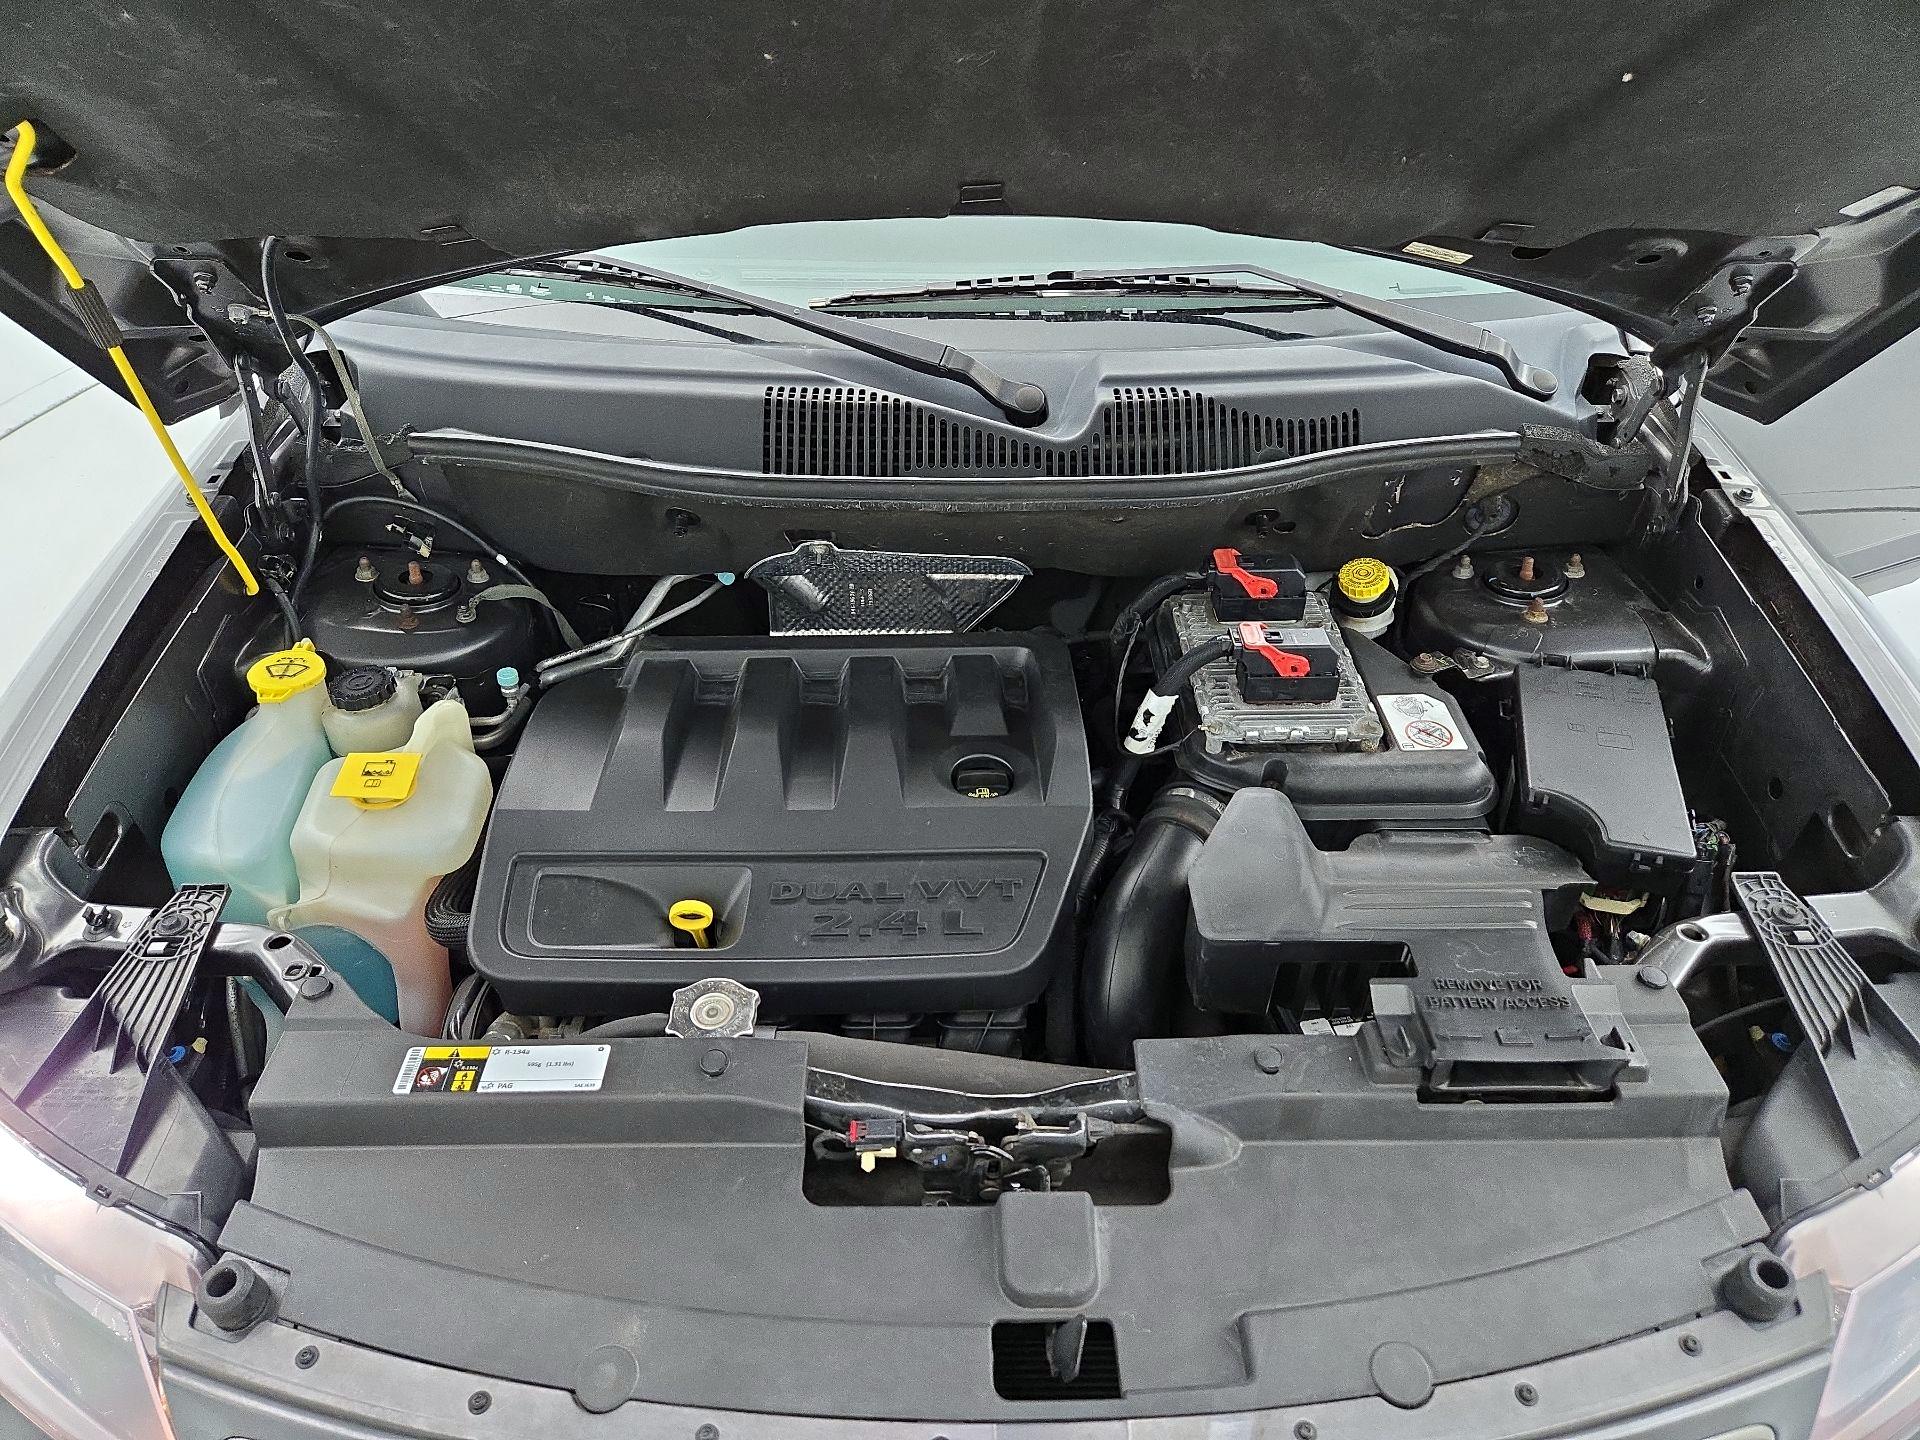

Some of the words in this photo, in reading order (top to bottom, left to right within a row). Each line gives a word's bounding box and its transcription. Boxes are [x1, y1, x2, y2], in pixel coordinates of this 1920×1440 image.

[769, 881, 905, 904] DUAL
[915, 879, 1023, 899] VVT
[1434, 977, 1505, 991] REMOVE
[1508, 978, 1543, 991] FOR
[1426, 996, 1498, 1009] BATTERY
[1503, 996, 1571, 1010] ACCESS
